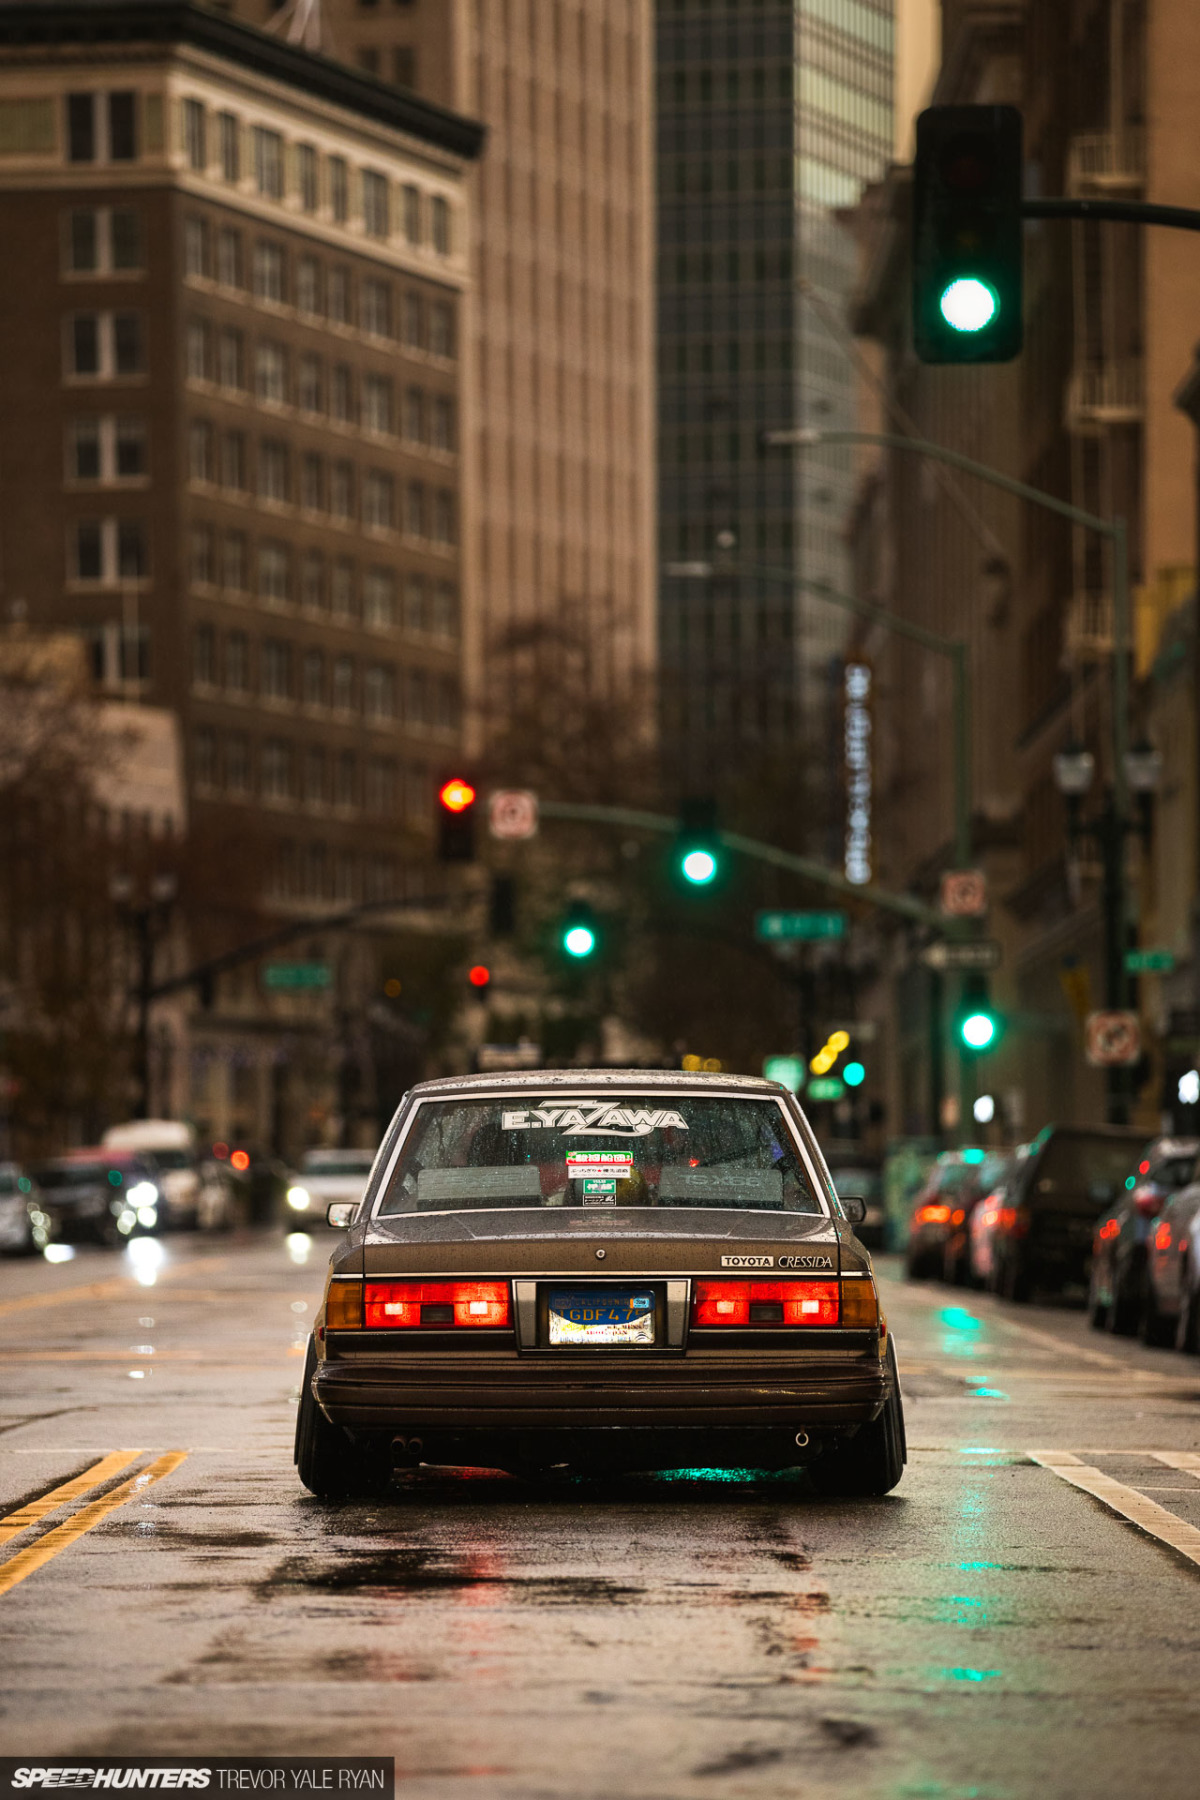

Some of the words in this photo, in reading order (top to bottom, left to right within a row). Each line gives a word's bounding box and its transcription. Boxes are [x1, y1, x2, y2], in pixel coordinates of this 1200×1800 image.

[502, 1100, 689, 1136] E.YAZAWA
[724, 1257, 771, 1266] TOYOTA
[778, 1255, 833, 1268] CRESSIDA
